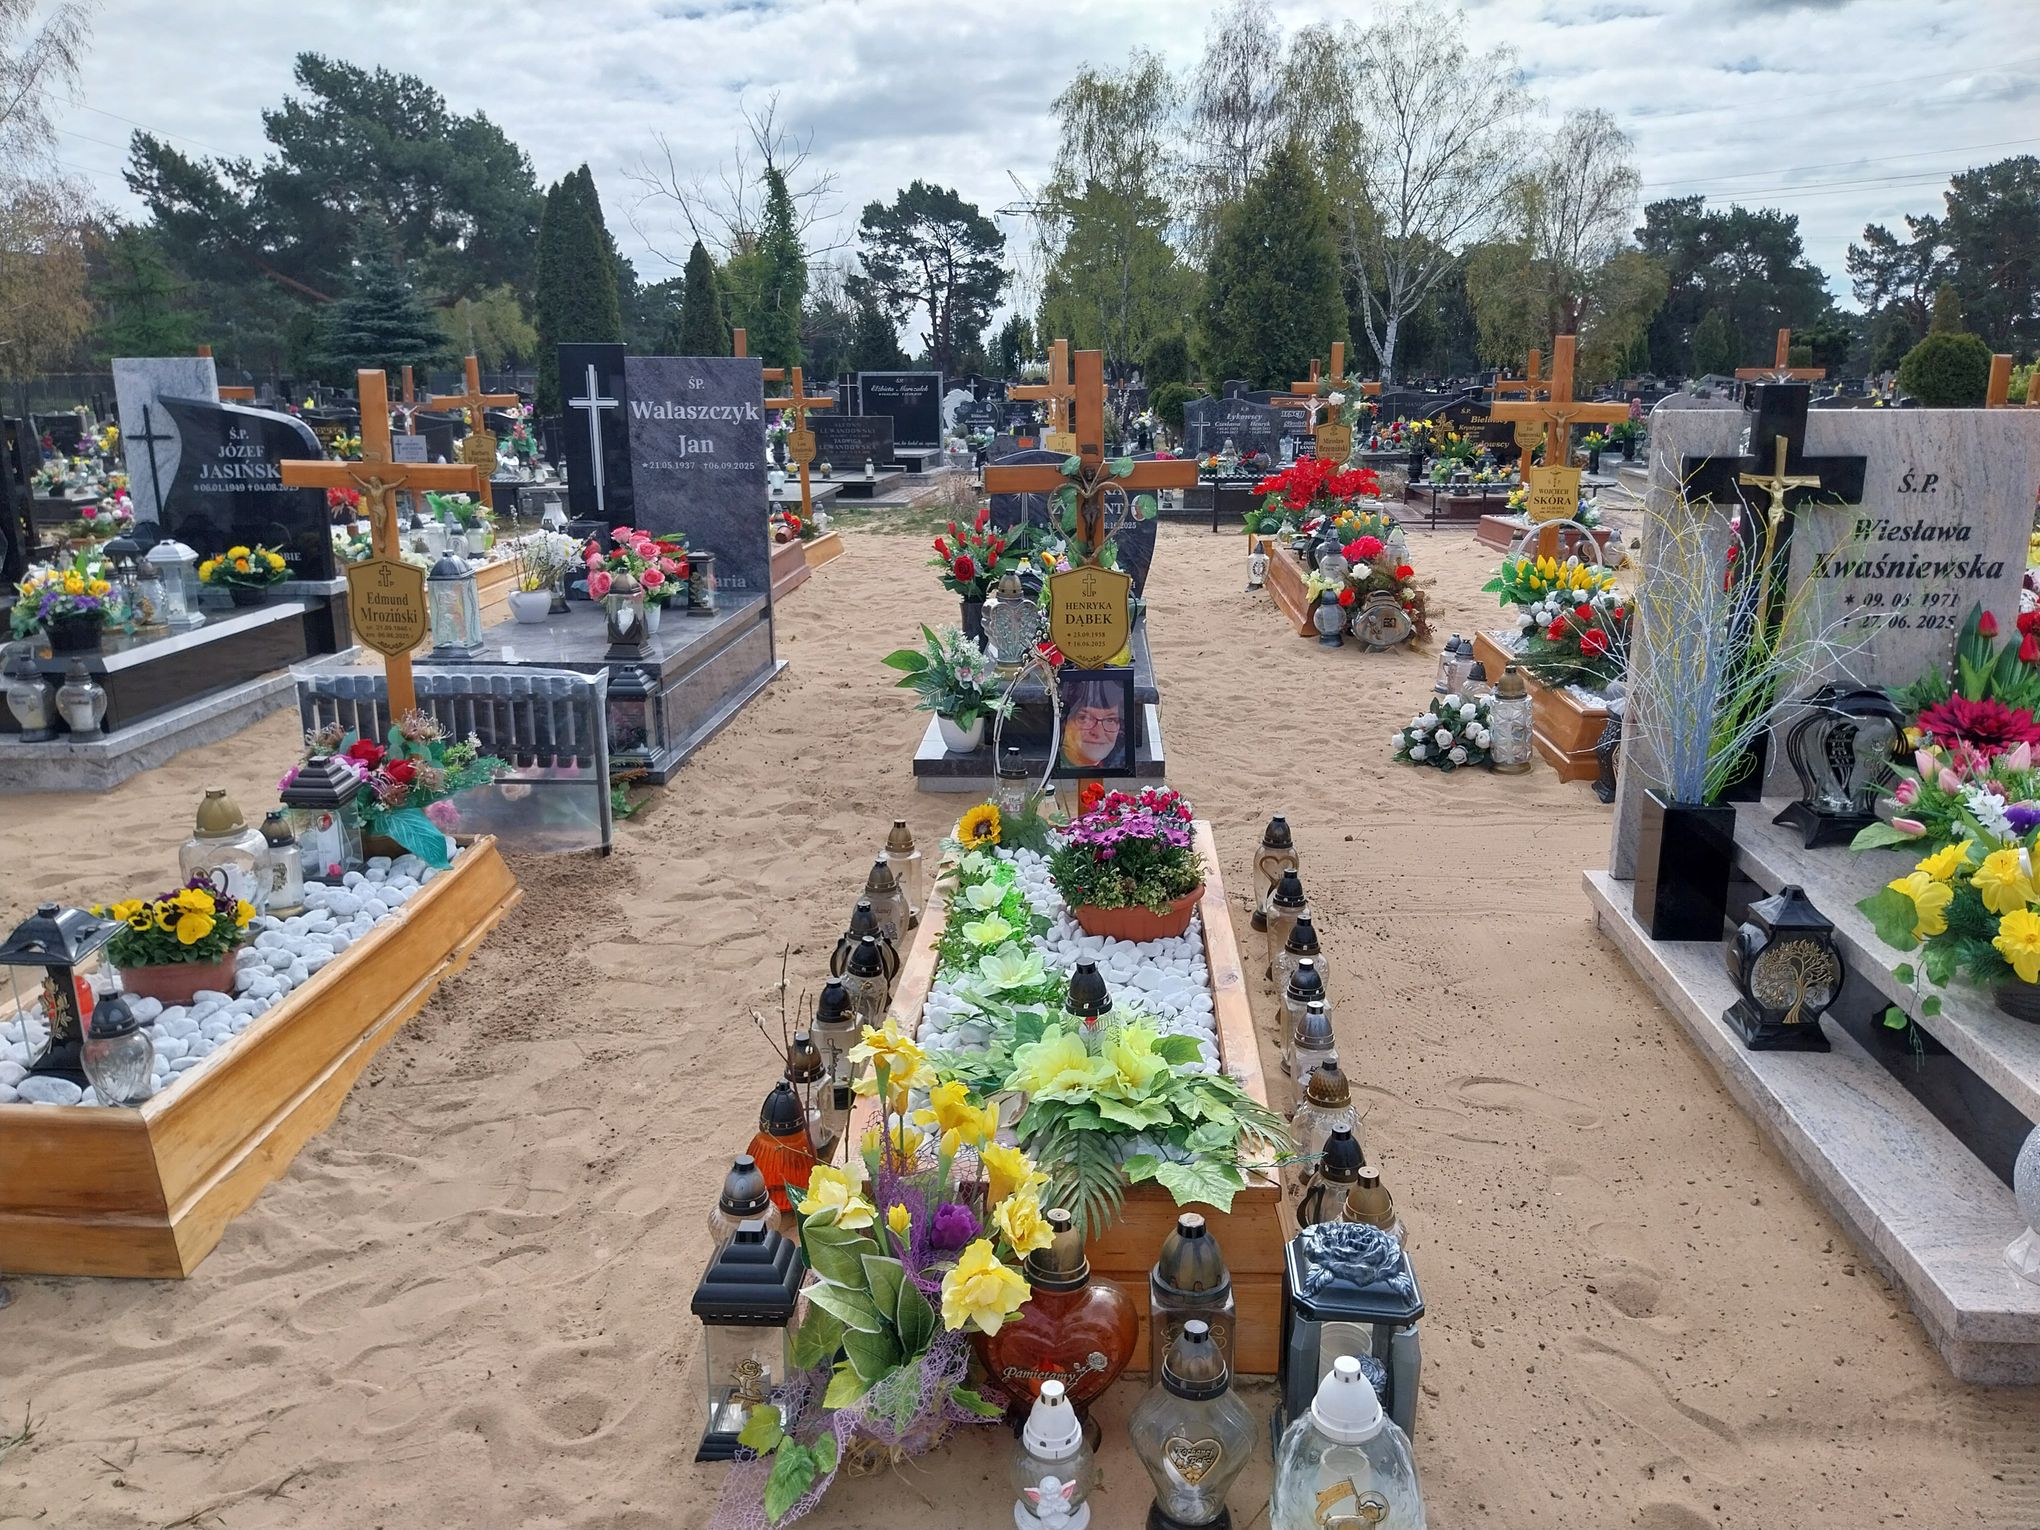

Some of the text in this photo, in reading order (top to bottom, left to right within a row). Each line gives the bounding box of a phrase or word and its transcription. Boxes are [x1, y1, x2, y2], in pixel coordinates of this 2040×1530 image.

[630, 400, 760, 426] Walaszczyk
[218, 442, 265, 458] JÓZEF
[678, 434, 715, 459] Jan
[200, 460, 282, 479] JASIŃSK
[649, 461, 755, 470] 21.05.1937 06.09.2025
[1533, 494, 1572, 505] SKÓRA
[1854, 519, 1972, 542] Wiesława
[1807, 552, 2005, 580] Kwaśniewska
[366, 591, 409, 606] Edmund
[1065, 602, 1112, 610] HENRYKA
[1920, 593, 1961, 608] 1971
[360, 607, 418, 624] Mroziński
[1065, 613, 1113, 628] DĄBEK
[1916, 615, 1957, 629] 2025
